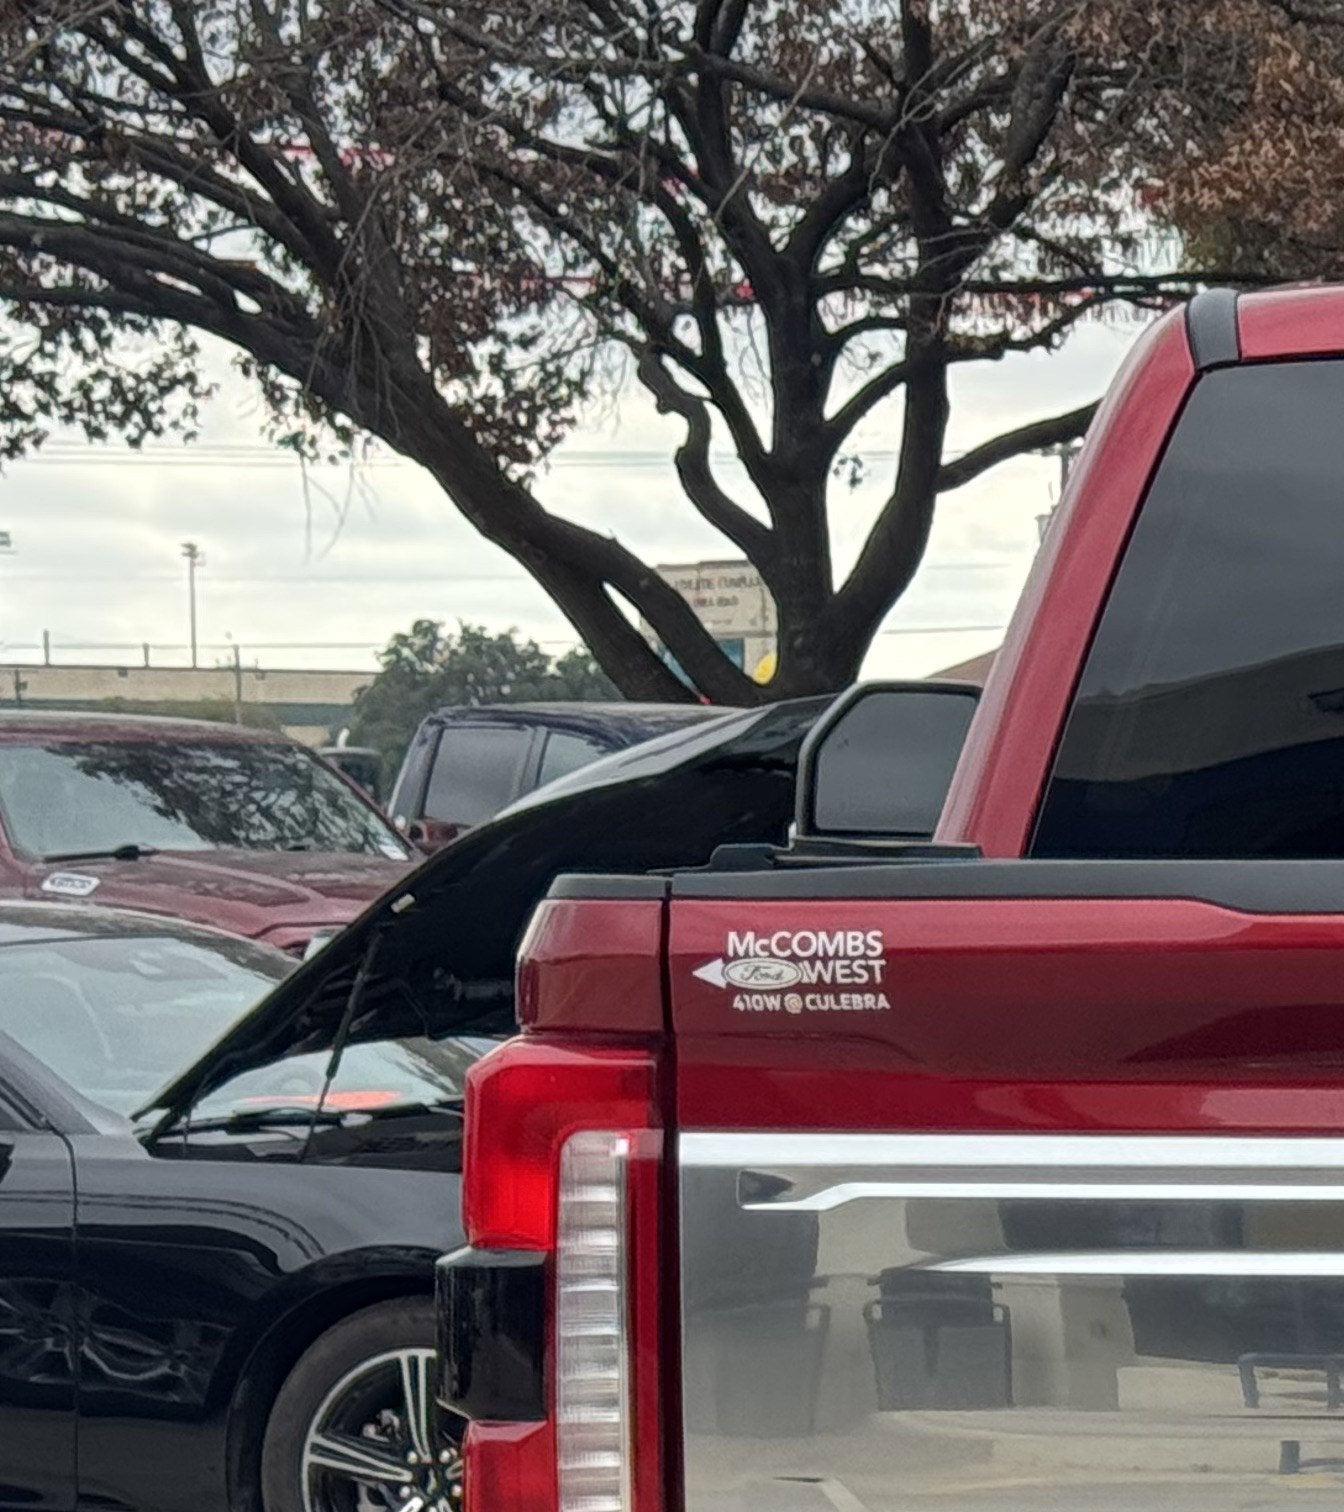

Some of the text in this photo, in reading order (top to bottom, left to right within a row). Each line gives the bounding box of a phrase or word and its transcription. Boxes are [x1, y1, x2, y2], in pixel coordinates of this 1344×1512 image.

[727, 930, 884, 958] McCOMBS
[800, 959, 887, 985] WEST
[805, 993, 892, 1010] CULEBRA
